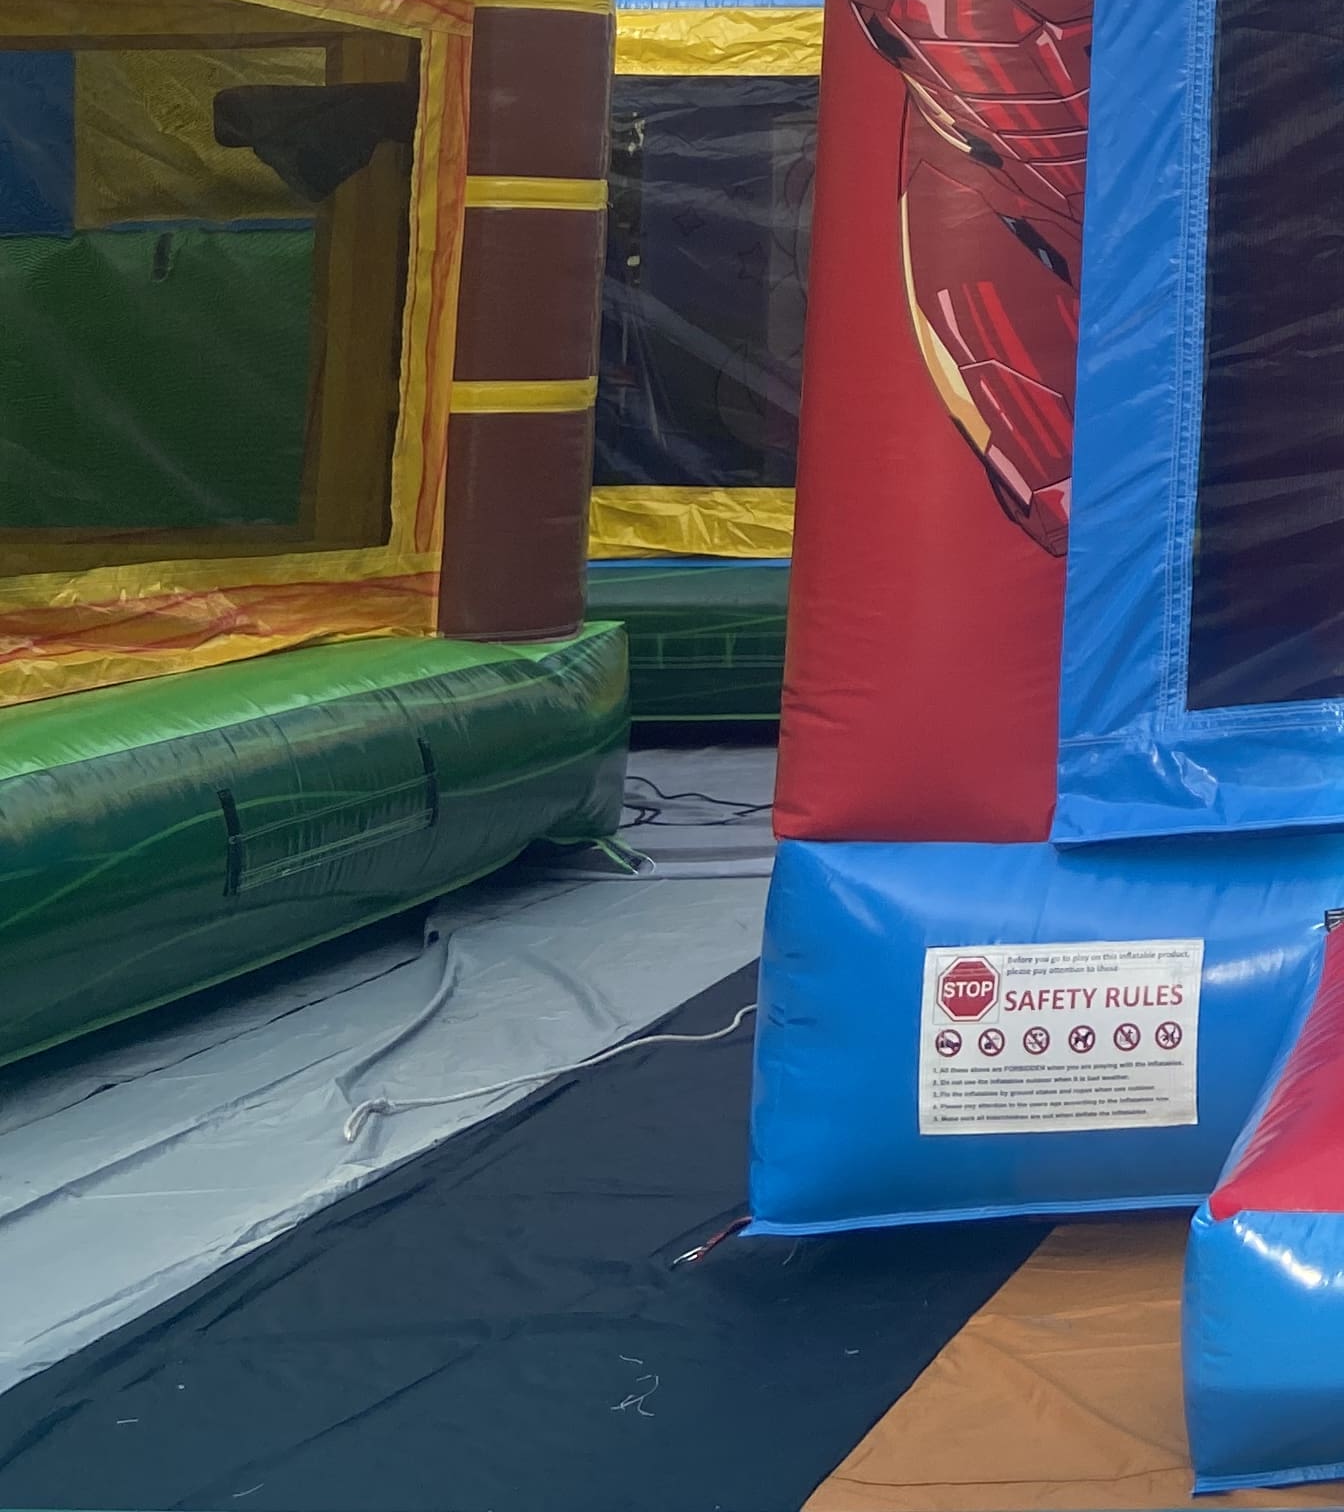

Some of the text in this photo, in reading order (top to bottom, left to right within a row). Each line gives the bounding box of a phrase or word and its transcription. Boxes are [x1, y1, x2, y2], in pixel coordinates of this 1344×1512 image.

[943, 981, 993, 999] STOP
[1004, 984, 1184, 1011] SAFETY RULES
